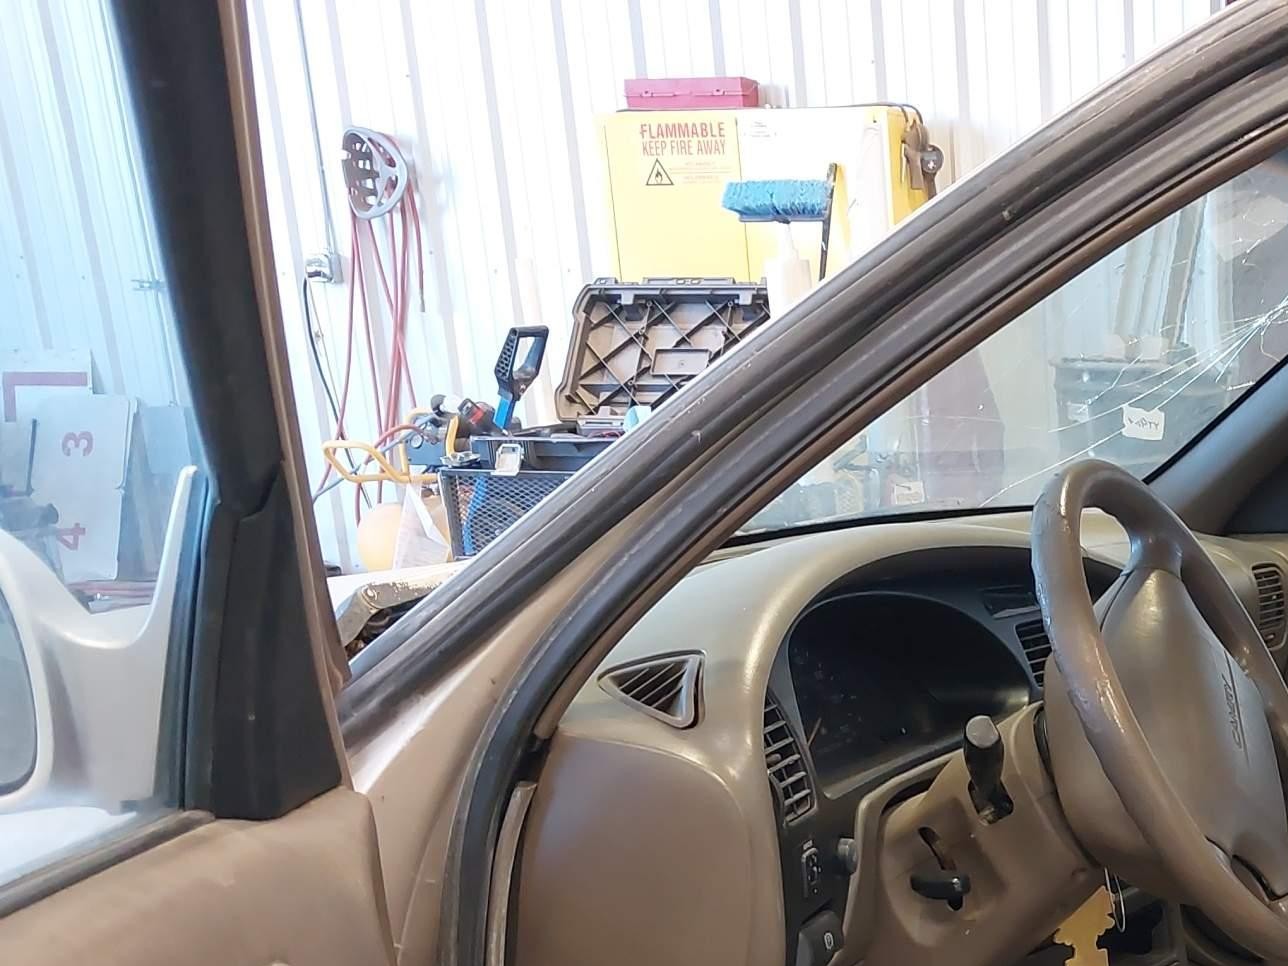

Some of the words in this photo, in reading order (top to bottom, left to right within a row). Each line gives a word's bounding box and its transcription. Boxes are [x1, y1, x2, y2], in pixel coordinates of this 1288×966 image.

[640, 122, 726, 139] FLAMMABLE
[642, 140, 667, 156] KEEP
[670, 140, 693, 155] FIRE
[697, 139, 726, 155] AWAY
[61, 431, 93, 456] 3
